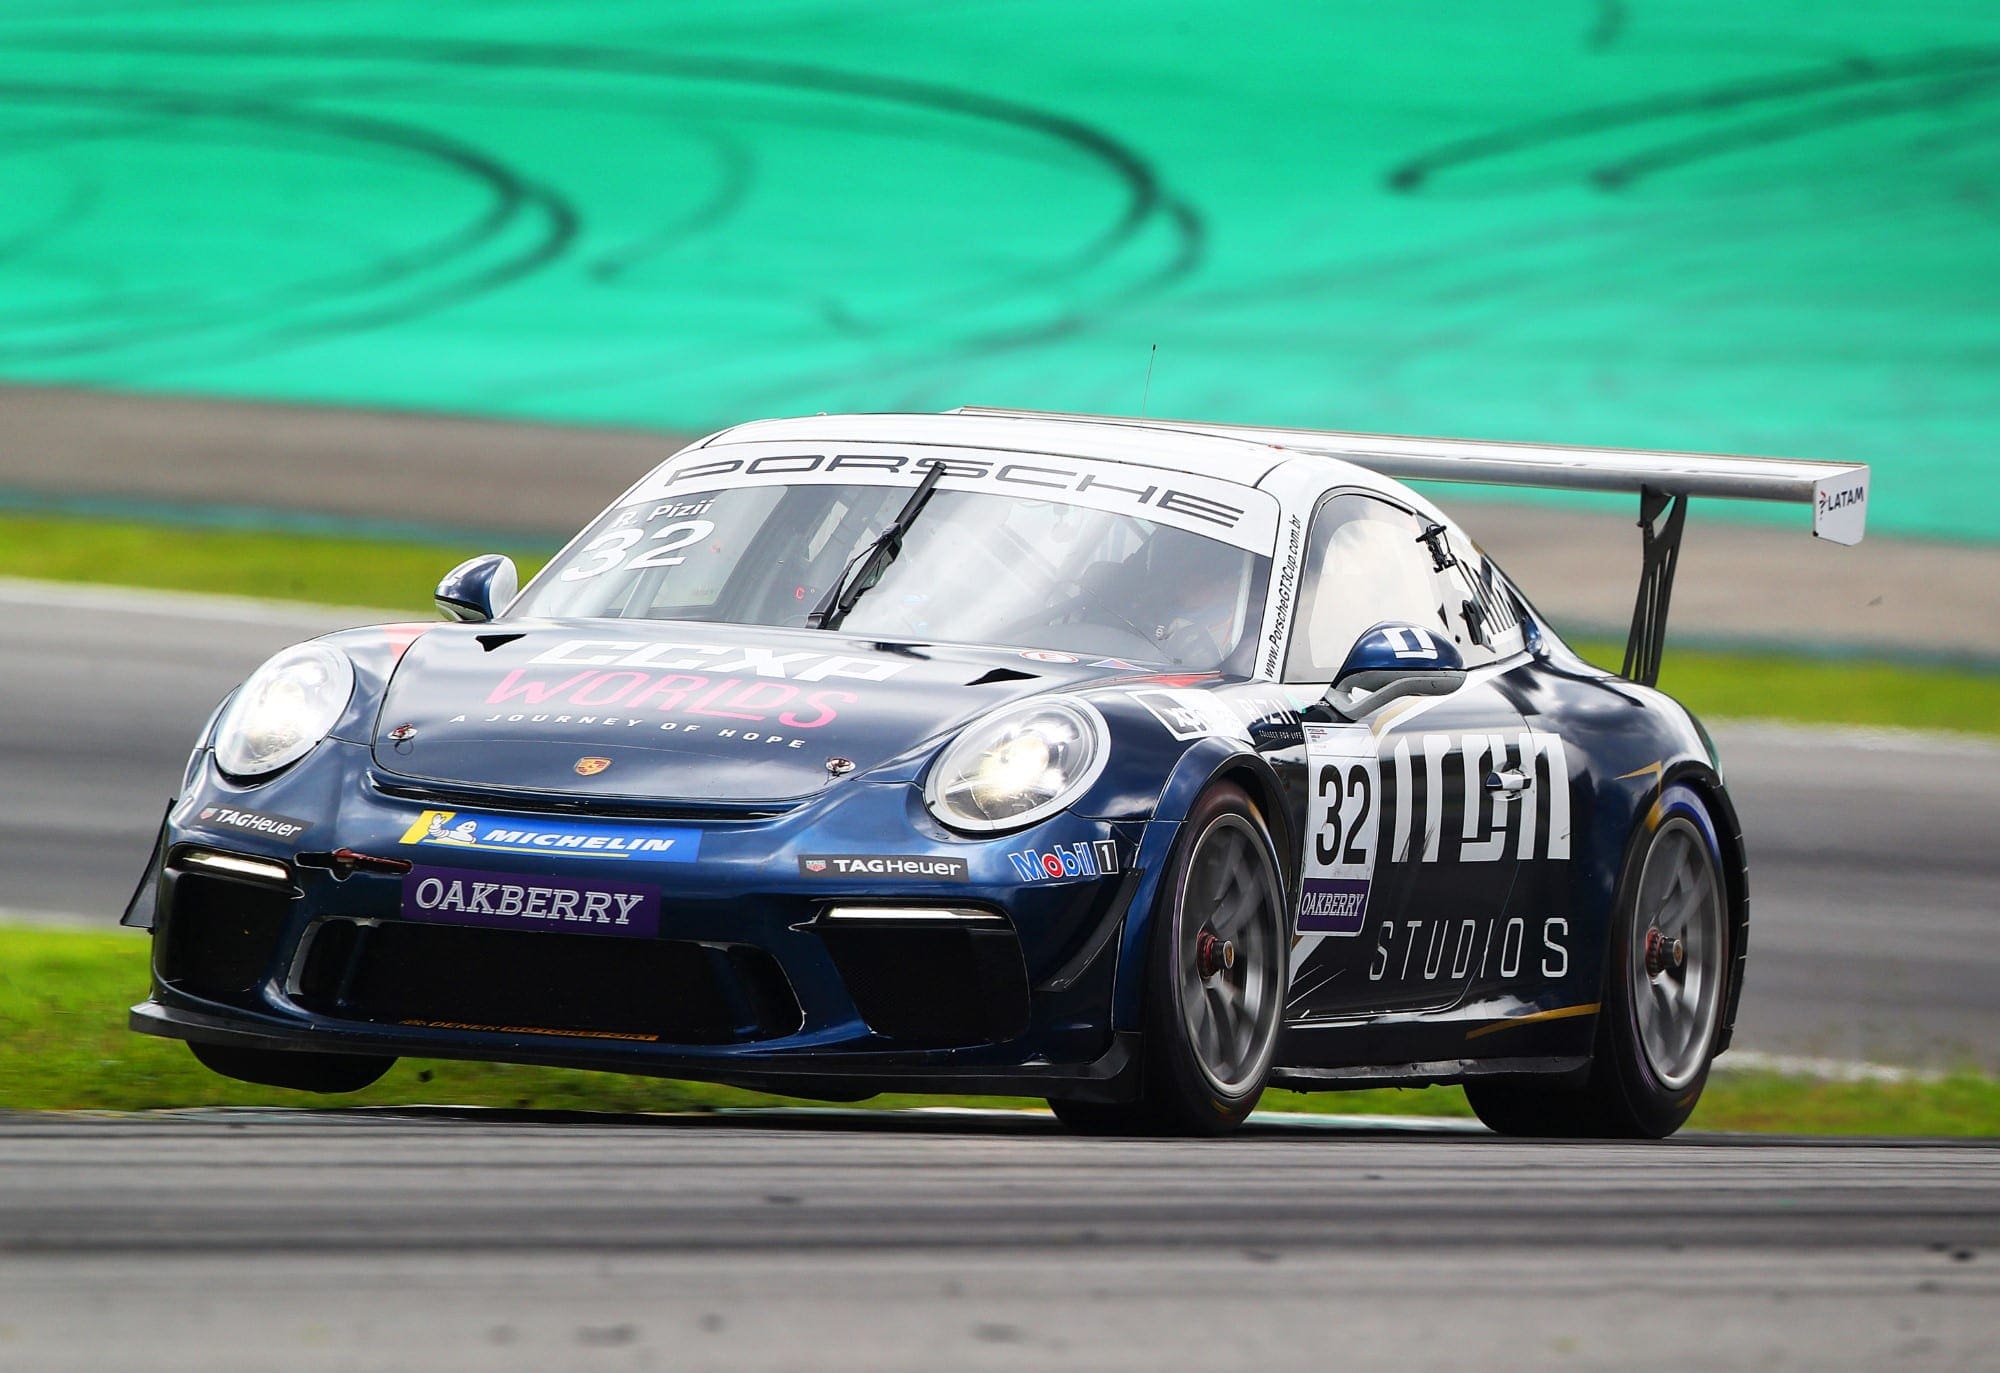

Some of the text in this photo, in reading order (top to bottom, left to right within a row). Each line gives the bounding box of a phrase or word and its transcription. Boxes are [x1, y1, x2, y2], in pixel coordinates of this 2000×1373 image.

[611, 499, 717, 529] R. Pizii
[664, 454, 1245, 529] PORSCHE
[1828, 486, 1864, 511] LATAM
[560, 519, 716, 582] 32
[1264, 514, 1301, 678] www.PorscheGT3Cup.com.br
[528, 639, 913, 683] CCXP
[485, 669, 858, 729] WORLDS
[450, 713, 806, 749] A JOURNEY OF HOPE
[1315, 764, 1371, 867] 32
[485, 828, 676, 853] MICHELIN
[1008, 841, 1096, 882] Mobil
[415, 877, 644, 926] OAKBERRY
[1301, 892, 1365, 917] OAKBERRY
[1369, 917, 1569, 981] STUDIOS
